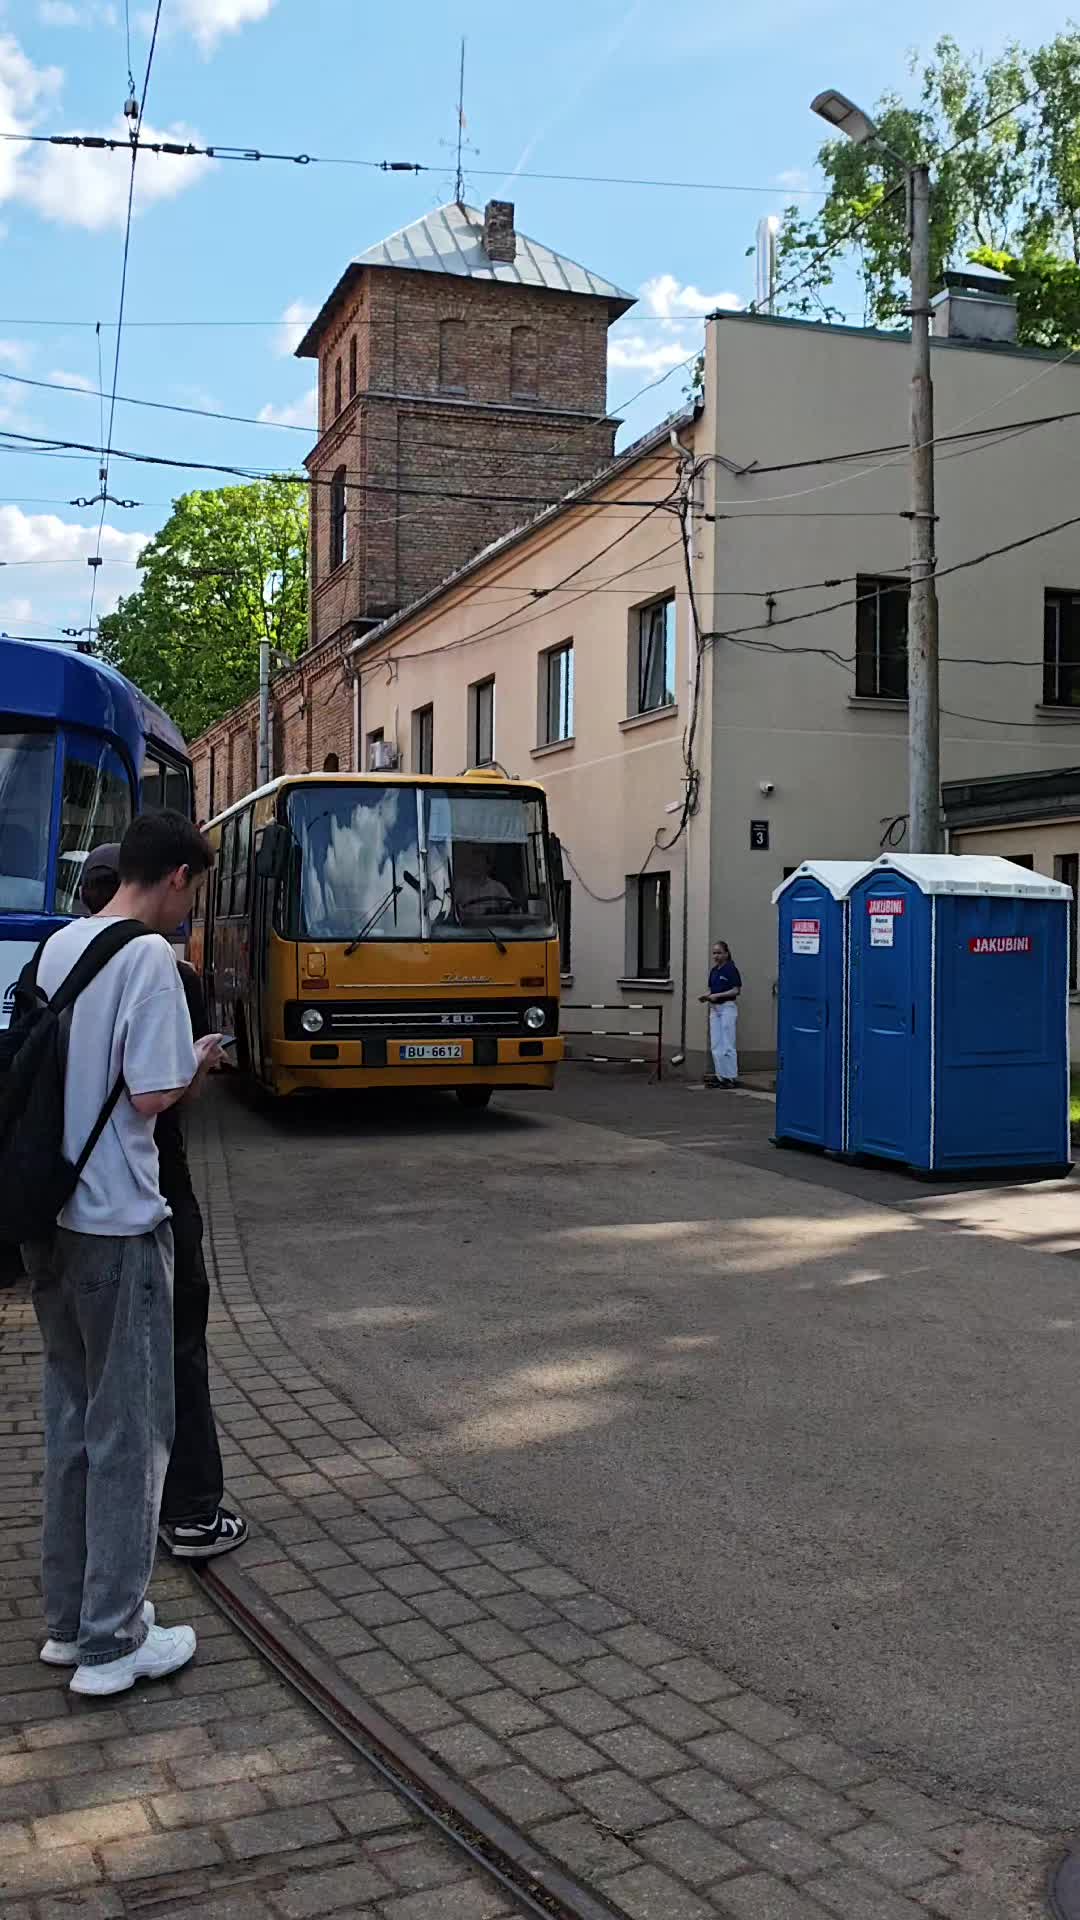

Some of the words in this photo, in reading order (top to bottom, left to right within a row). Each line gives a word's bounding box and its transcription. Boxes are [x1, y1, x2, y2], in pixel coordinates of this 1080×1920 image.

[756, 832, 763, 844] 3
[869, 900, 902, 913] JAKUBINI
[973, 937, 1029, 952] JAKUBINI
[408, 1046, 460, 1057] BU-6612
